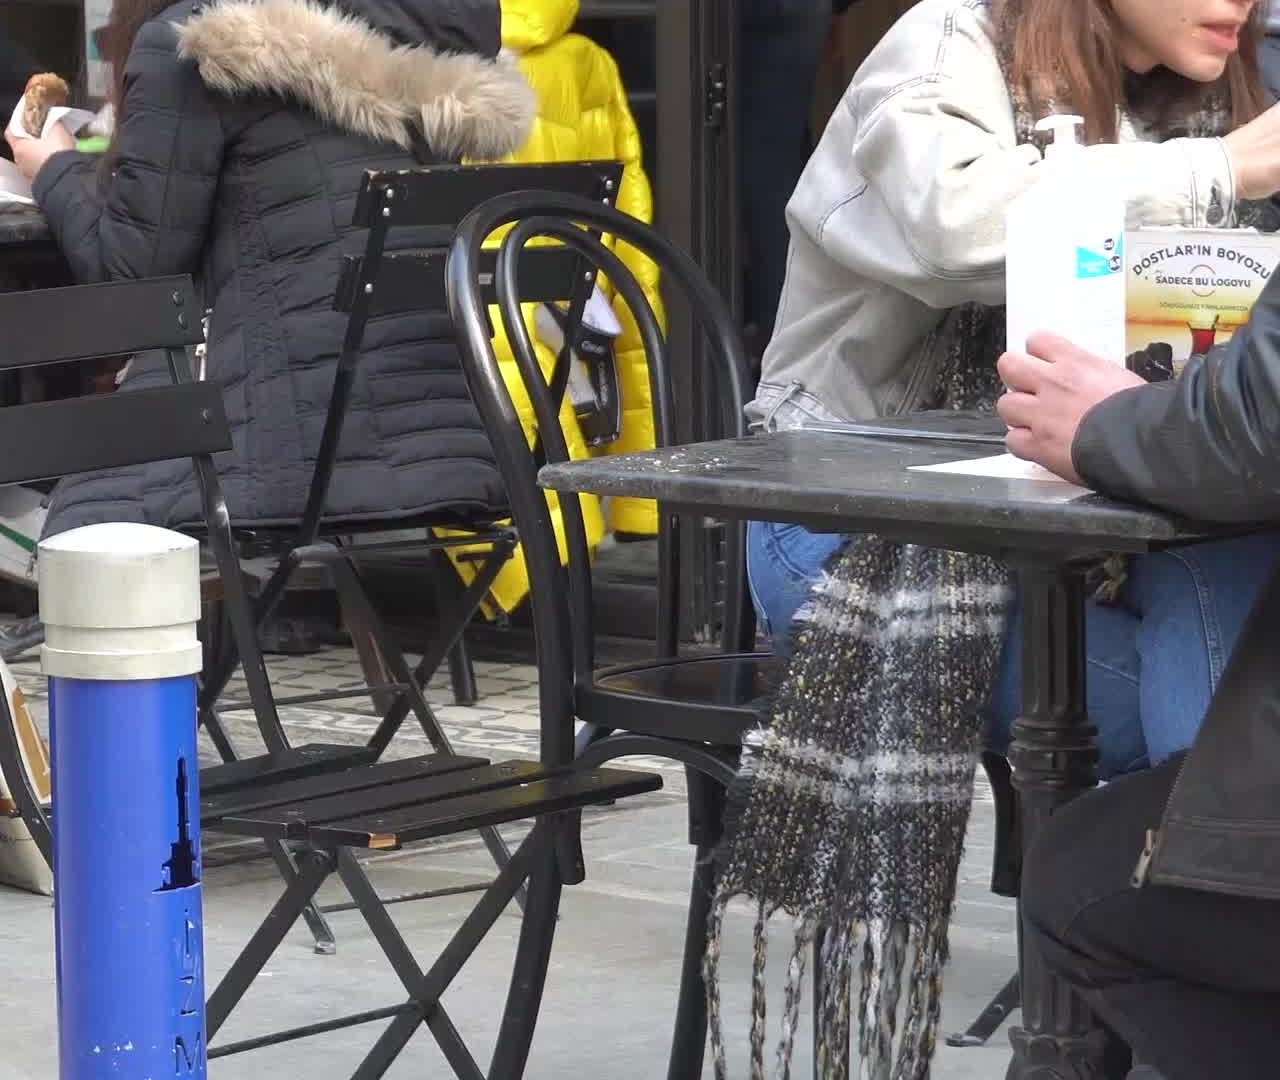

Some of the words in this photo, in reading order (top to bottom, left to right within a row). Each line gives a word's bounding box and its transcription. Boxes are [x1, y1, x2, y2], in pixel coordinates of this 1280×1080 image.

[1132, 244, 1212, 277] DOSTLAR'IN
[1216, 246, 1272, 280] BOYOZU
[1155, 275, 1193, 285] SADECE
[1195, 276, 1209, 286] BU
[1210, 277, 1251, 288] LOGOYU
